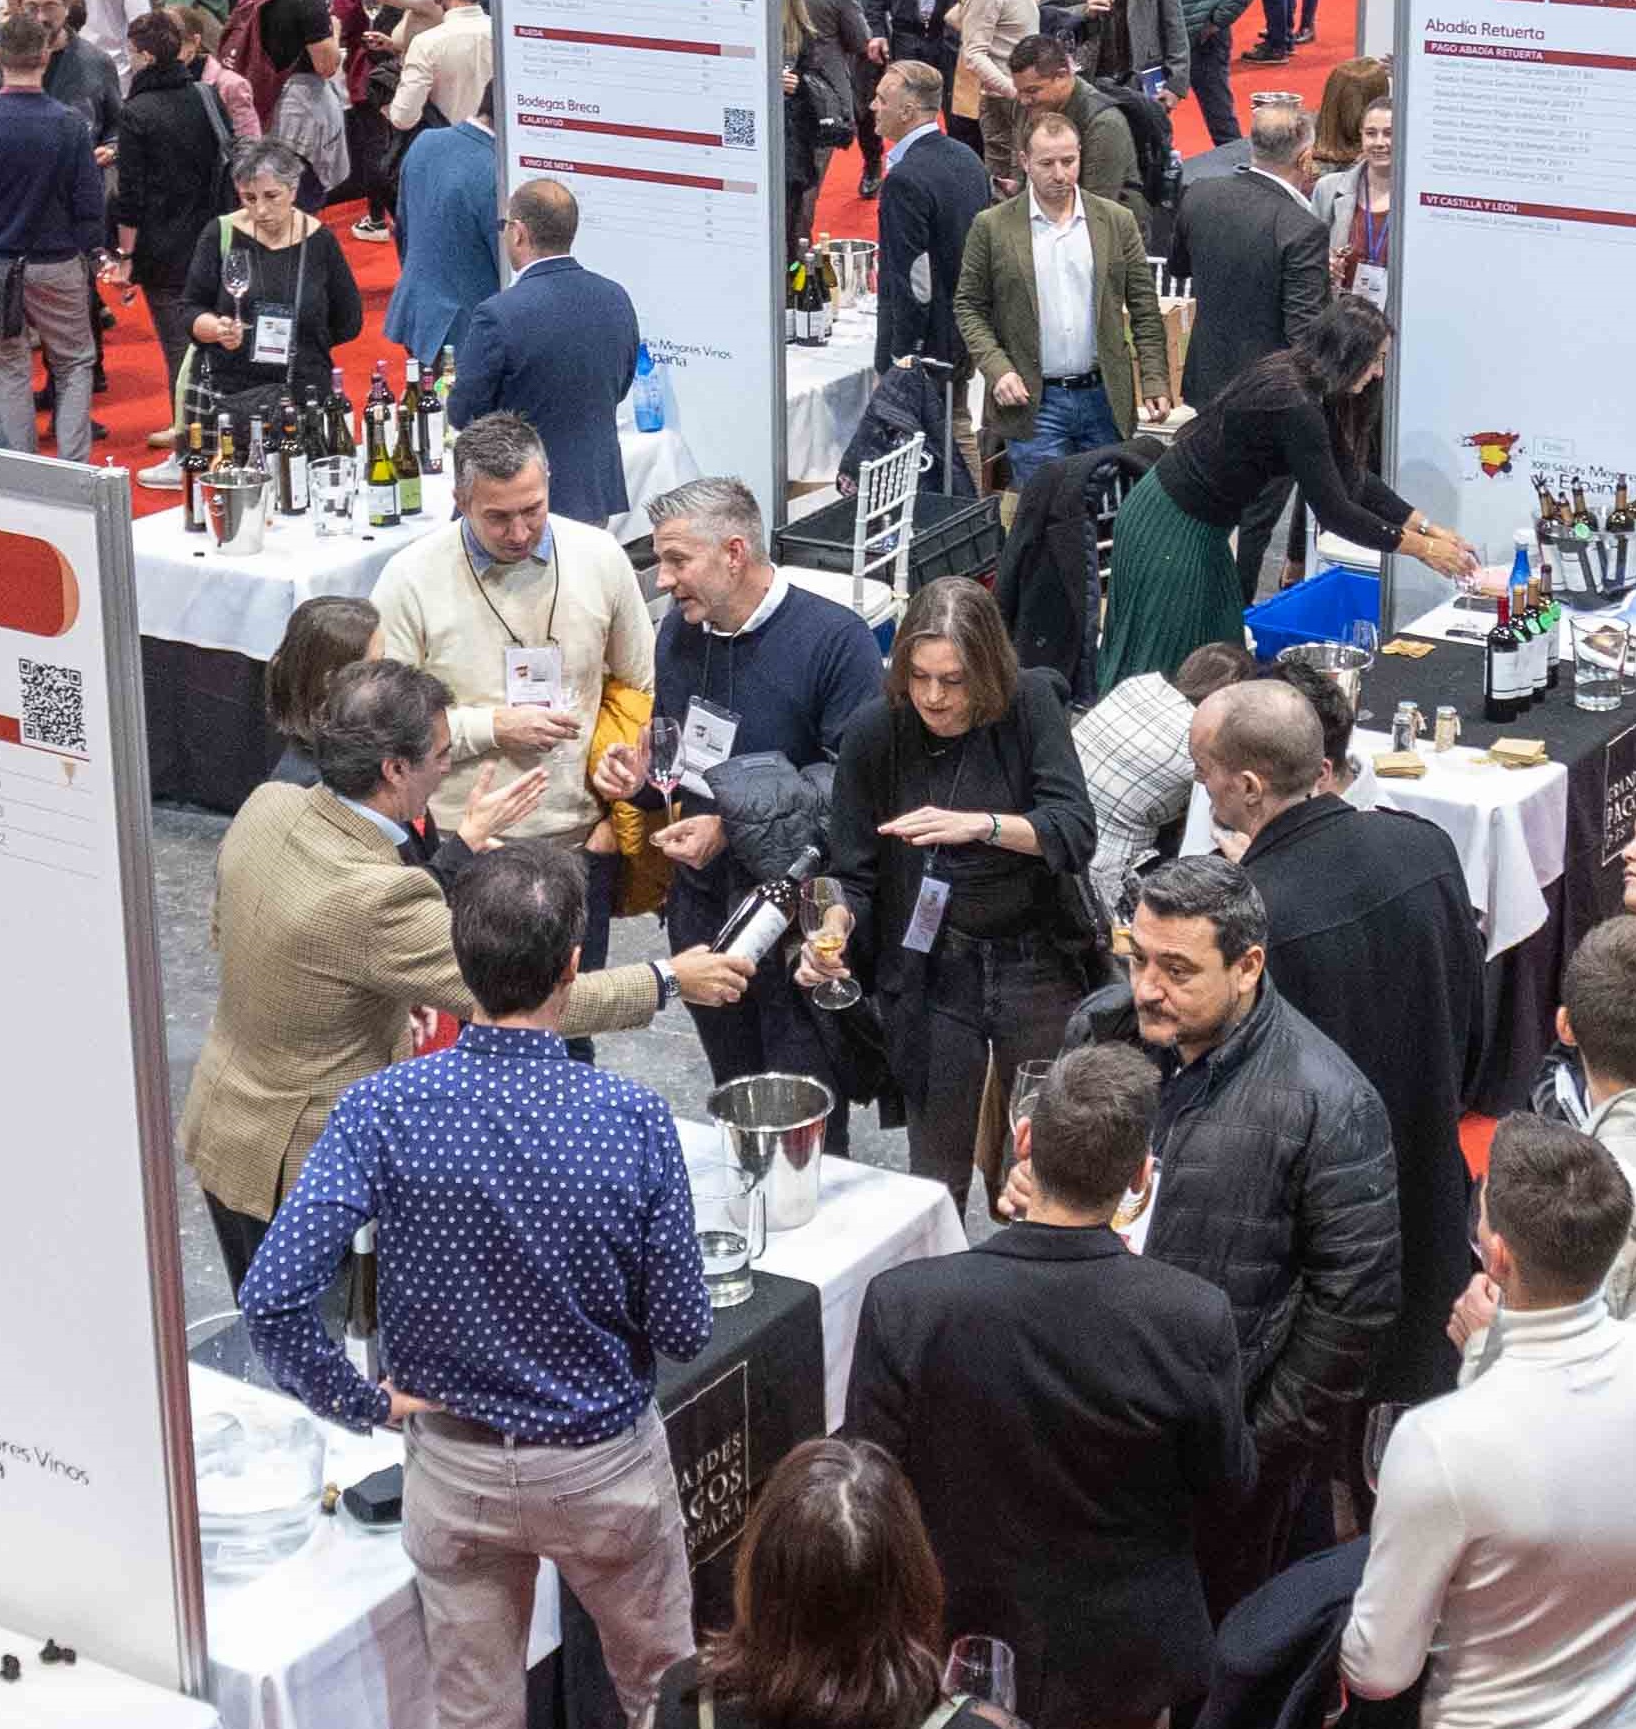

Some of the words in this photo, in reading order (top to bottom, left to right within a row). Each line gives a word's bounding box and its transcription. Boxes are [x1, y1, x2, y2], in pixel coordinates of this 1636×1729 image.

[1424, 17, 1478, 37] Abadía
[1481, 21, 1546, 42] Retuerta
[1431, 42, 1458, 53] PAGO
[516, 93, 566, 111] Bodegas
[567, 98, 600, 114] Breca
[33, 1445, 90, 1486] Vinos
